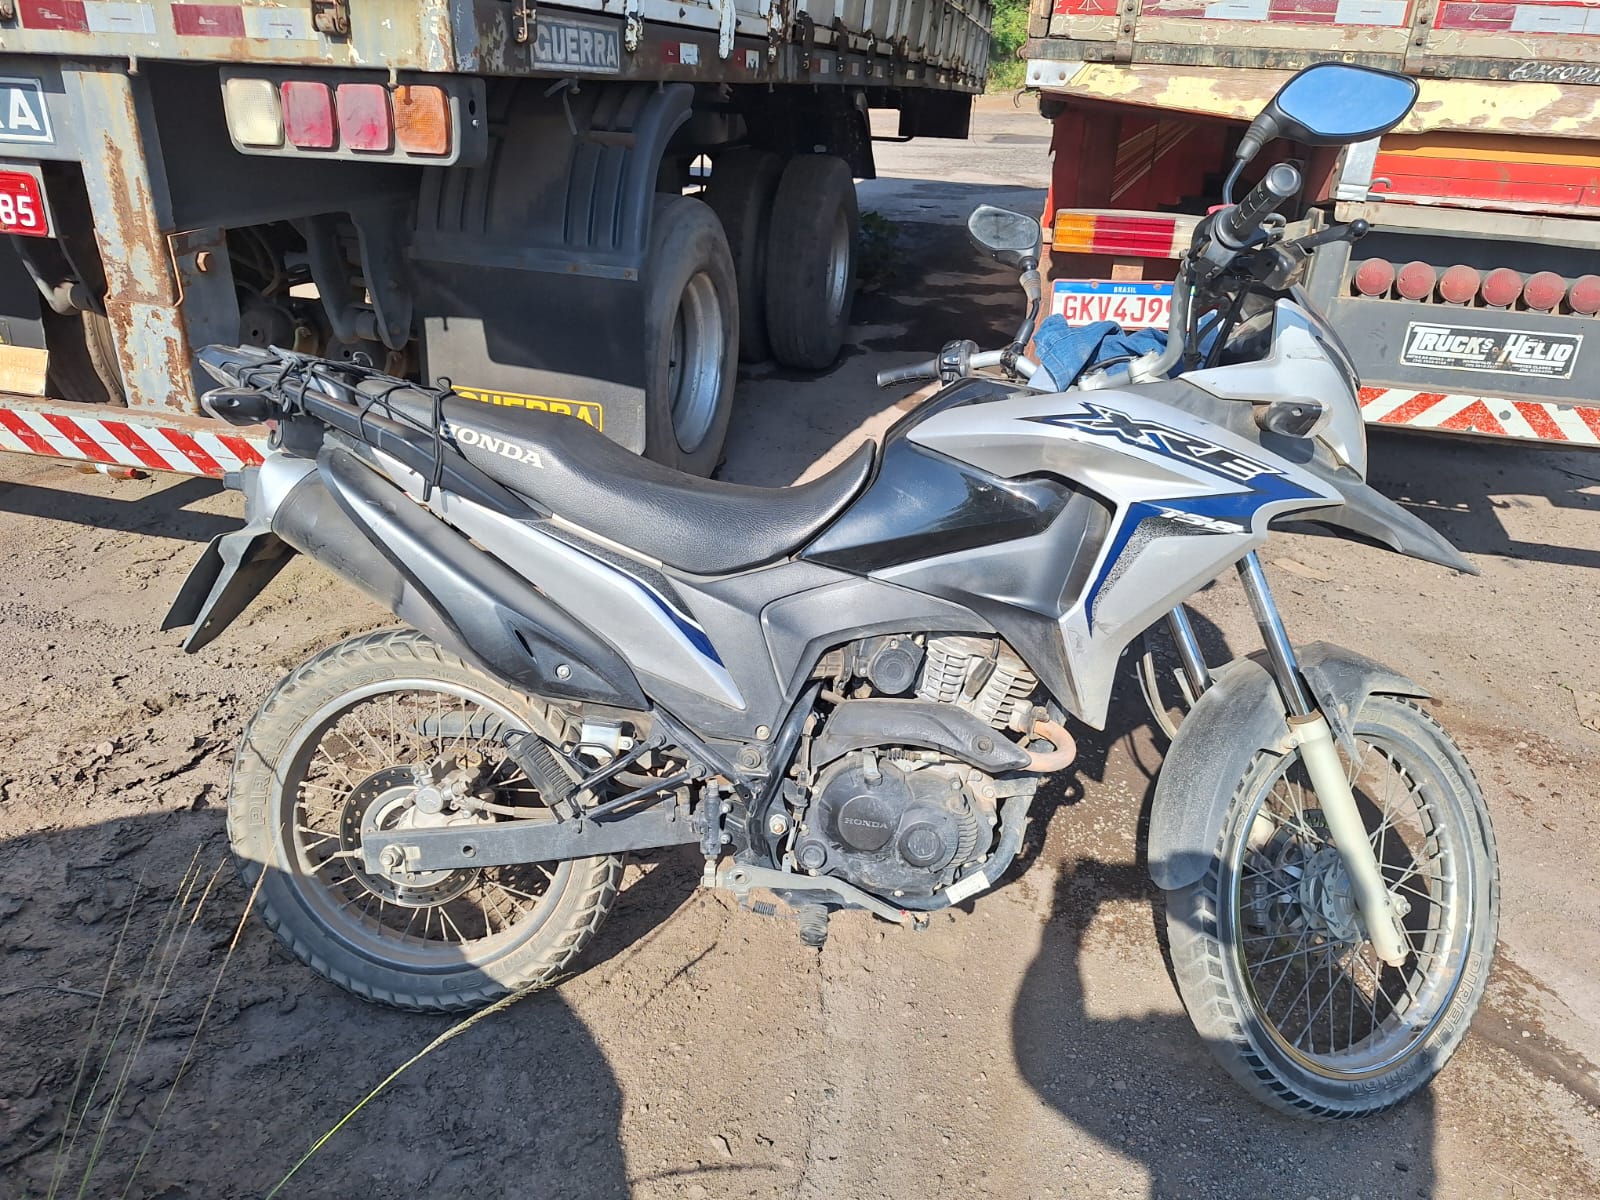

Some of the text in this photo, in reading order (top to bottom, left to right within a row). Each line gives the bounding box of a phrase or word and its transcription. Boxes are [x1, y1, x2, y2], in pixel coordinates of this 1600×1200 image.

[534, 24, 617, 66] GUERRA
[0, 88, 41, 130] A
[1113, 286, 1137, 294] BRASIL
[439, 420, 545, 469] HONDA
[844, 817, 889, 830] HONDA
